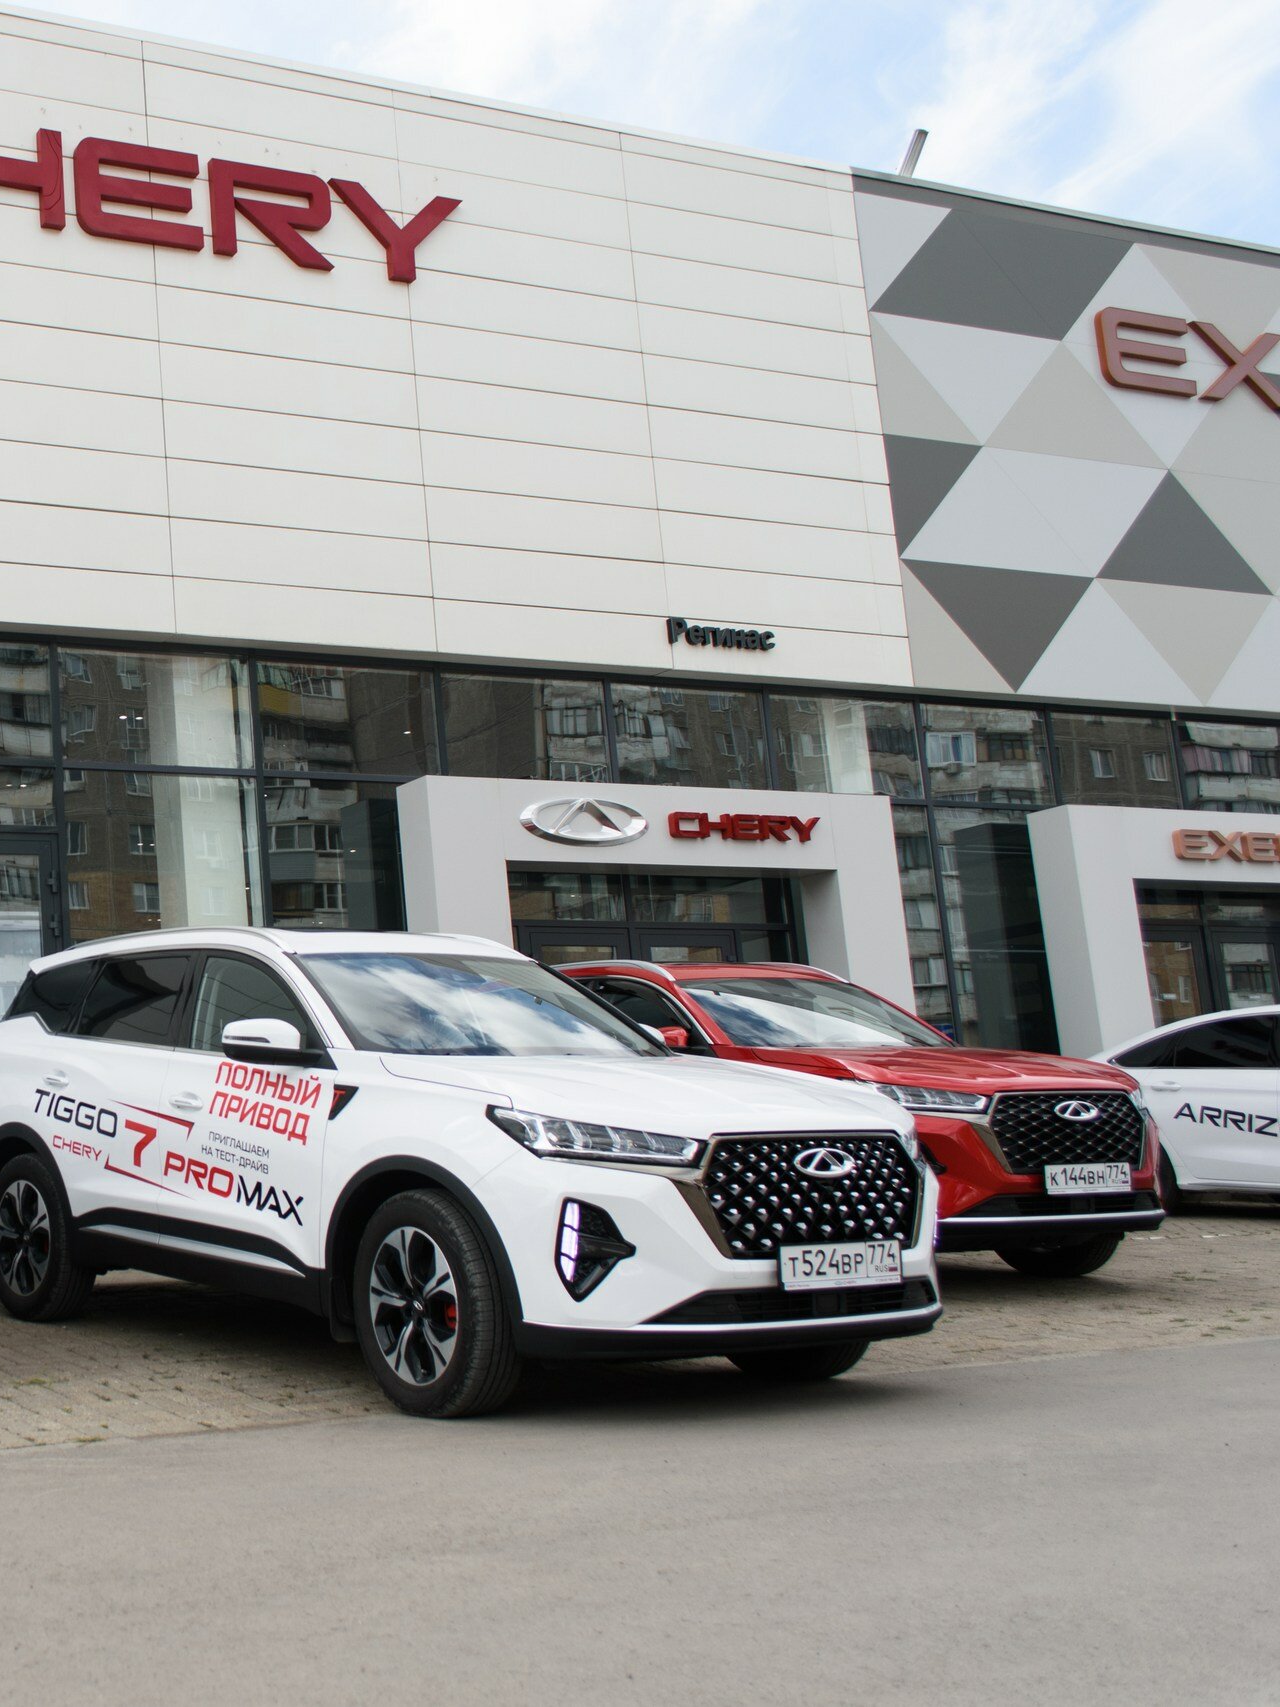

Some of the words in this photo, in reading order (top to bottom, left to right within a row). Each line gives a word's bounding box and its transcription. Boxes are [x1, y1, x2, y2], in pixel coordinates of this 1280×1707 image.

[666, 616, 776, 651] Регинас
[668, 811, 821, 843] CHERY
[1171, 829, 1280, 862] EXE
[215, 1061, 322, 1108] ПОЛНЫЙ
[34, 1088, 118, 1138] TIGGO
[124, 1119, 158, 1168] 7
[209, 1091, 310, 1146] ПРИВОД
[1173, 1102, 1280, 1138] ARRIZ
[52, 1135, 102, 1162] CHERY
[201, 1144, 213, 1157] НА
[215, 1148, 269, 1175] ТЕСТ-ДРАЙВ
[208, 1131, 270, 1158] ПРИГЛАШАЕМ
[867, 1243, 896, 1265] 774
